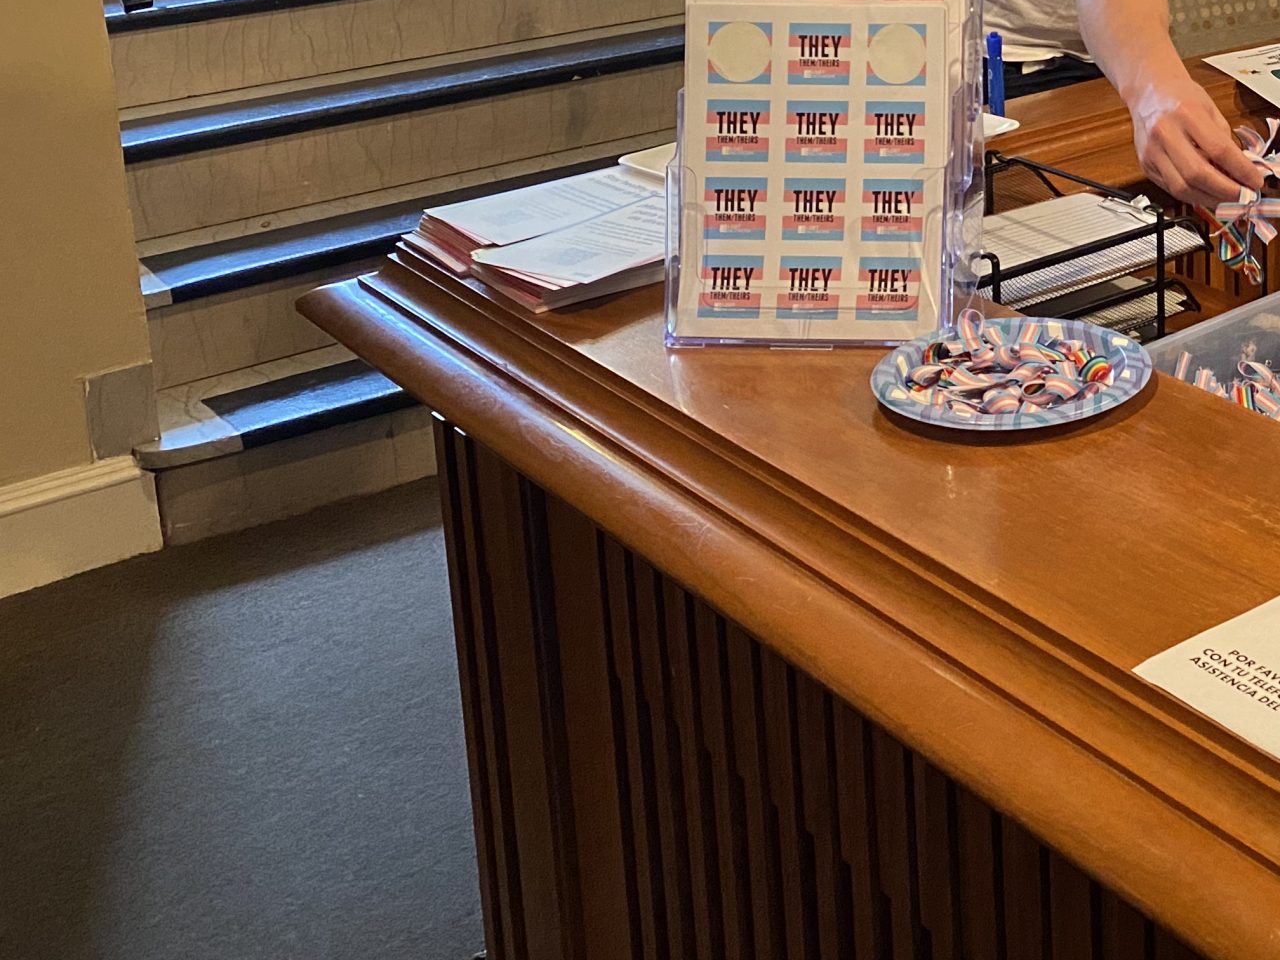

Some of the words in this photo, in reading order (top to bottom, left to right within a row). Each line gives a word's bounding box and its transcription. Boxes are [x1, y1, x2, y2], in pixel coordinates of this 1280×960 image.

[798, 35, 842, 58] THEY
[799, 59, 840, 67] THEM/THEIRS
[716, 111, 760, 135] THEY
[795, 112, 840, 136] THEY
[874, 113, 916, 137] THEY
[717, 135, 759, 144] THEM/THEIRS
[796, 136, 837, 145] THEM/THEIRS
[874, 137, 915, 146] THEM/THEIRS
[714, 188, 758, 213] THEY
[793, 190, 837, 213] THEY
[872, 191, 915, 214] THEY
[714, 213, 756, 222] THEM/THEIRS
[793, 214, 834, 223] THEM/THEIRS
[710, 267, 754, 290] THEY
[788, 268, 832, 292] THEY
[868, 269, 911, 292] THEY
[709, 291, 751, 300] THEM/THEIRS
[788, 292, 829, 301] THEM/THEIRS
[867, 293, 908, 302] THEM/THEIRS
[1203, 648, 1233, 667] CON
[1231, 666, 1249, 678] TU
[1228, 649, 1256, 668] POR
[1189, 656, 1258, 698] ASISTENCIA
